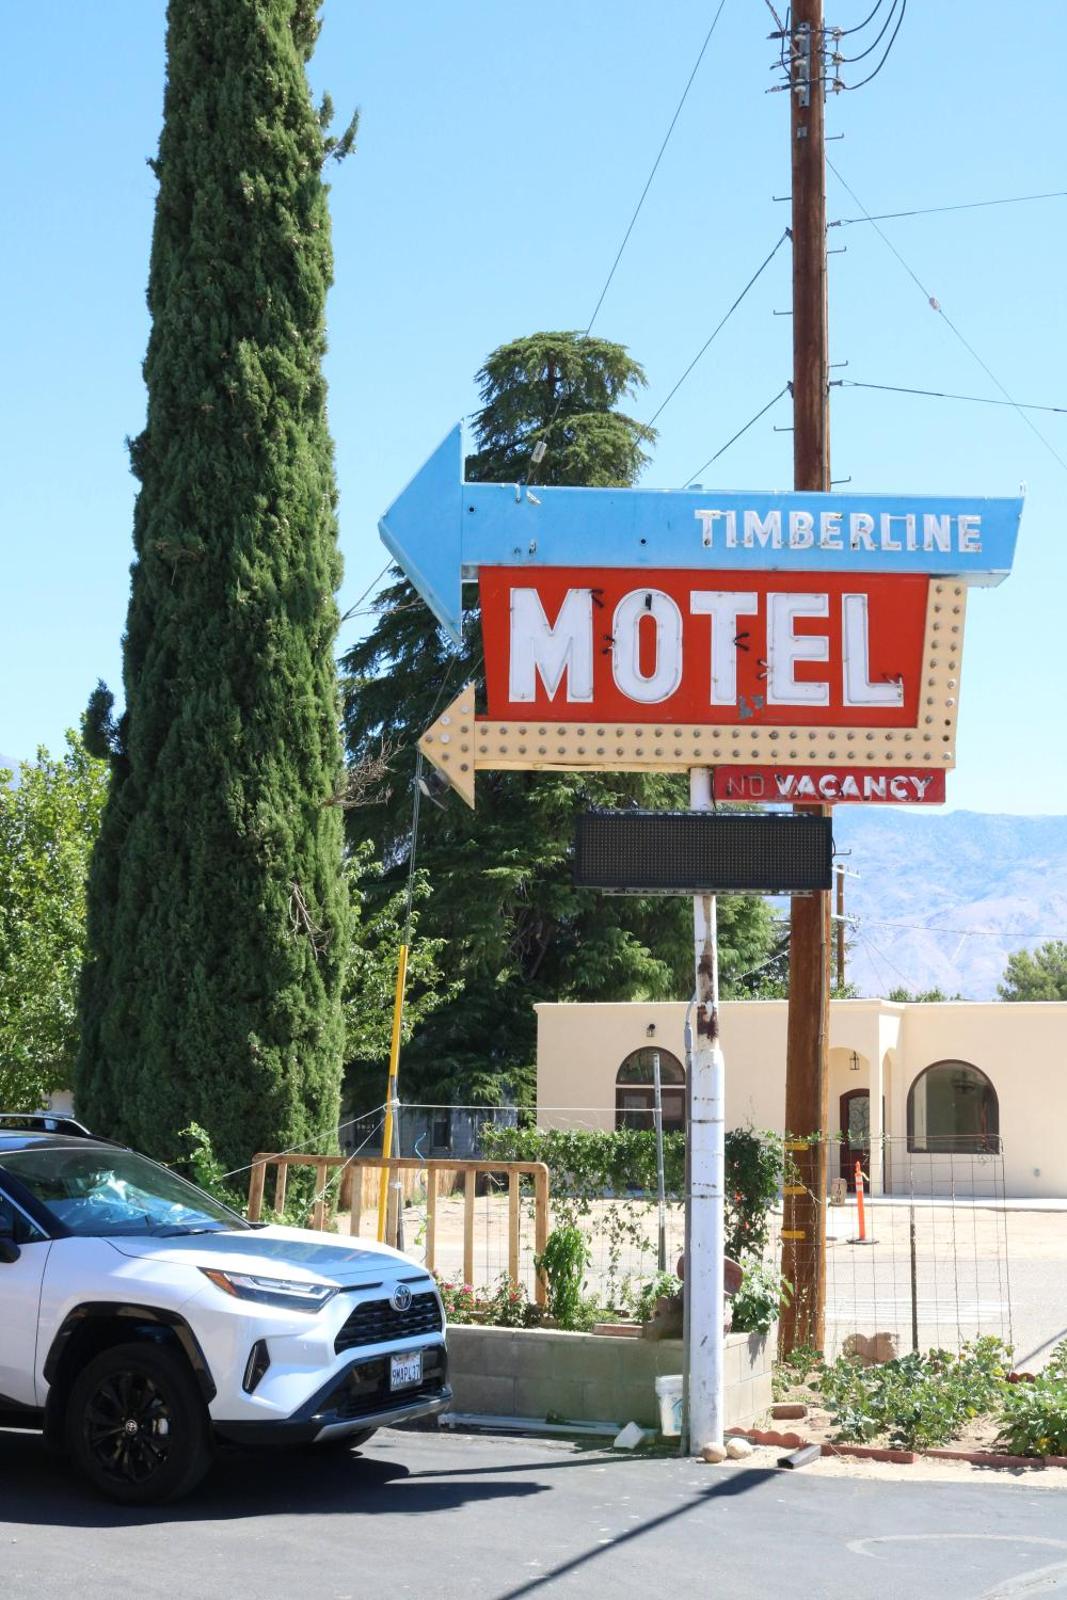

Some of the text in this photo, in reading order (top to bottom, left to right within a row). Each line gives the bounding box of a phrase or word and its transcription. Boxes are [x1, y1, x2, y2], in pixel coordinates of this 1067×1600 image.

[695, 509, 983, 553] TIMBERLINE
[509, 588, 904, 708] MOTEL
[727, 774, 933, 801] NO VACANCY
